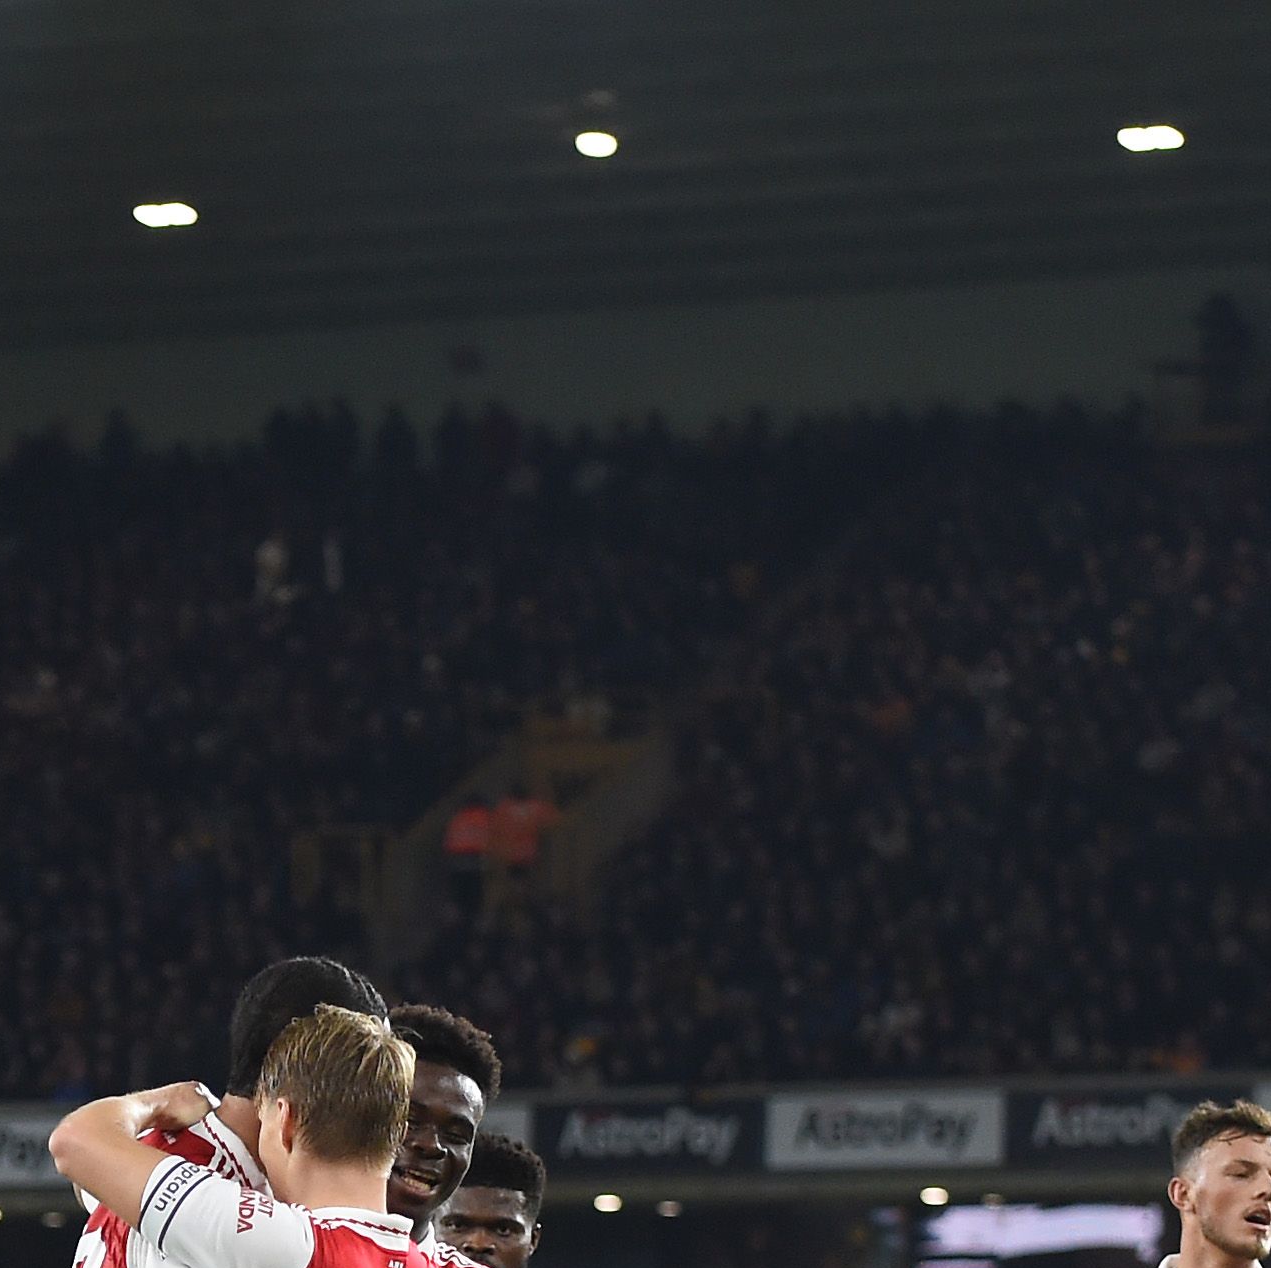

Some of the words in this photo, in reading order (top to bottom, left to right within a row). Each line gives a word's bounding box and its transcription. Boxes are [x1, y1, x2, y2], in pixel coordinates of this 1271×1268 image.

[558, 1106, 741, 1164] AstroPay
[792, 1101, 977, 1162] AstroPay
[1032, 1095, 1179, 1147] AstroP
[154, 1165, 201, 1211] aptain
[237, 1187, 255, 1233] NDA
